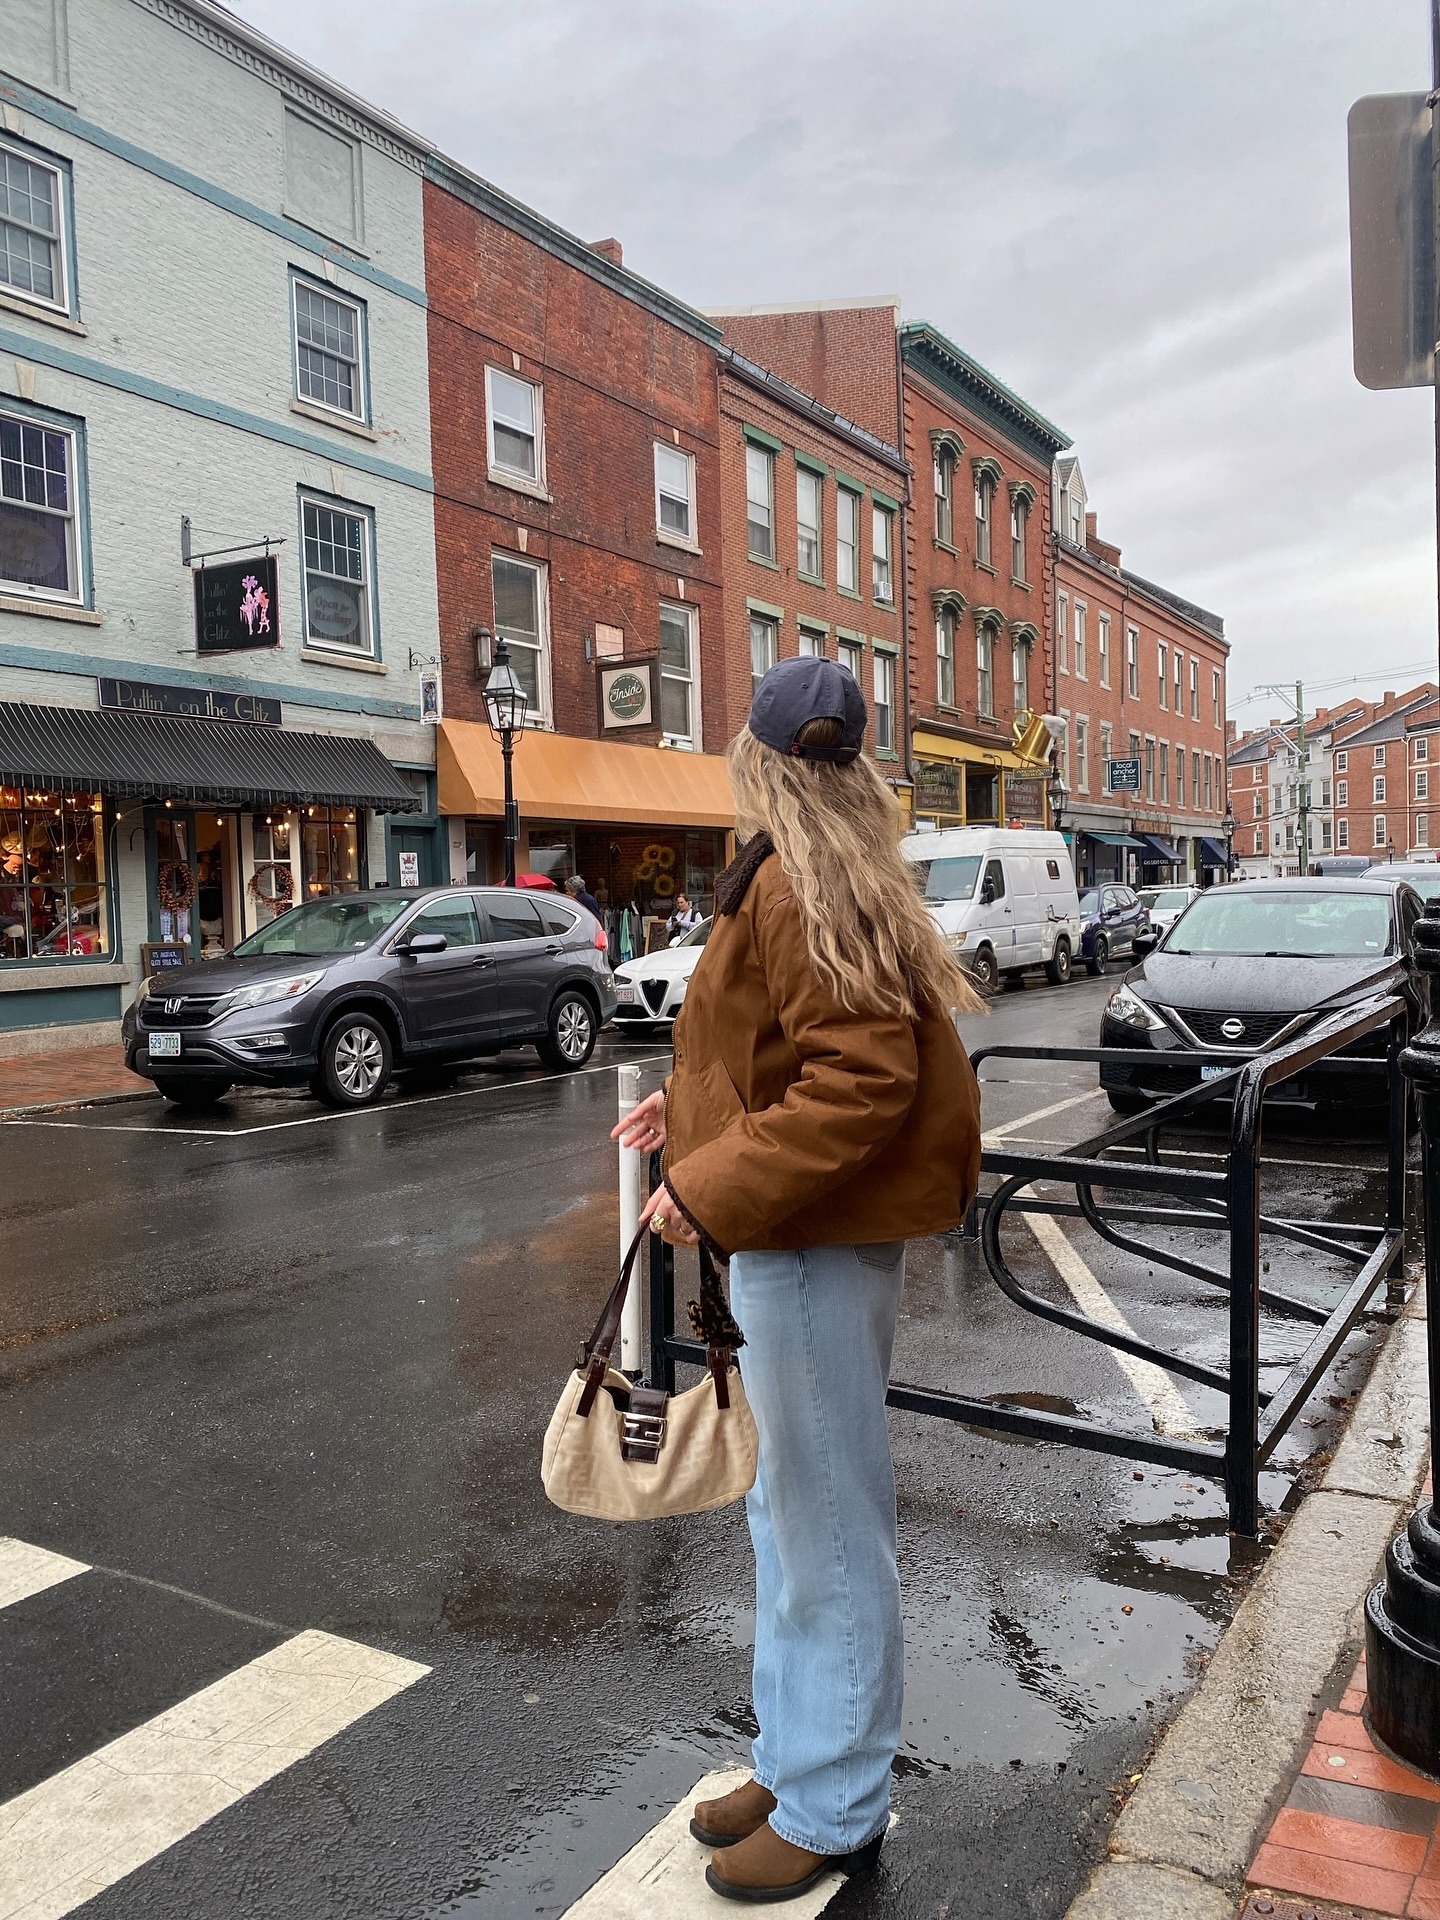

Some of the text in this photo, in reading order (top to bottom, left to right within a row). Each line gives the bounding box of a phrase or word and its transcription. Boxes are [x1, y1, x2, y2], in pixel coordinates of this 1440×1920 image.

[315, 596, 338, 611] Open
[315, 609, 352, 628] Readings
[203, 623, 230, 642] Glitz
[115, 680, 269, 723] Puttin' on the Glitz
[609, 683, 643, 703] Inside
[1112, 767, 1137, 775] anchor
[1116, 761, 1133, 769] local
[150, 1037, 179, 1049] 529 7733
